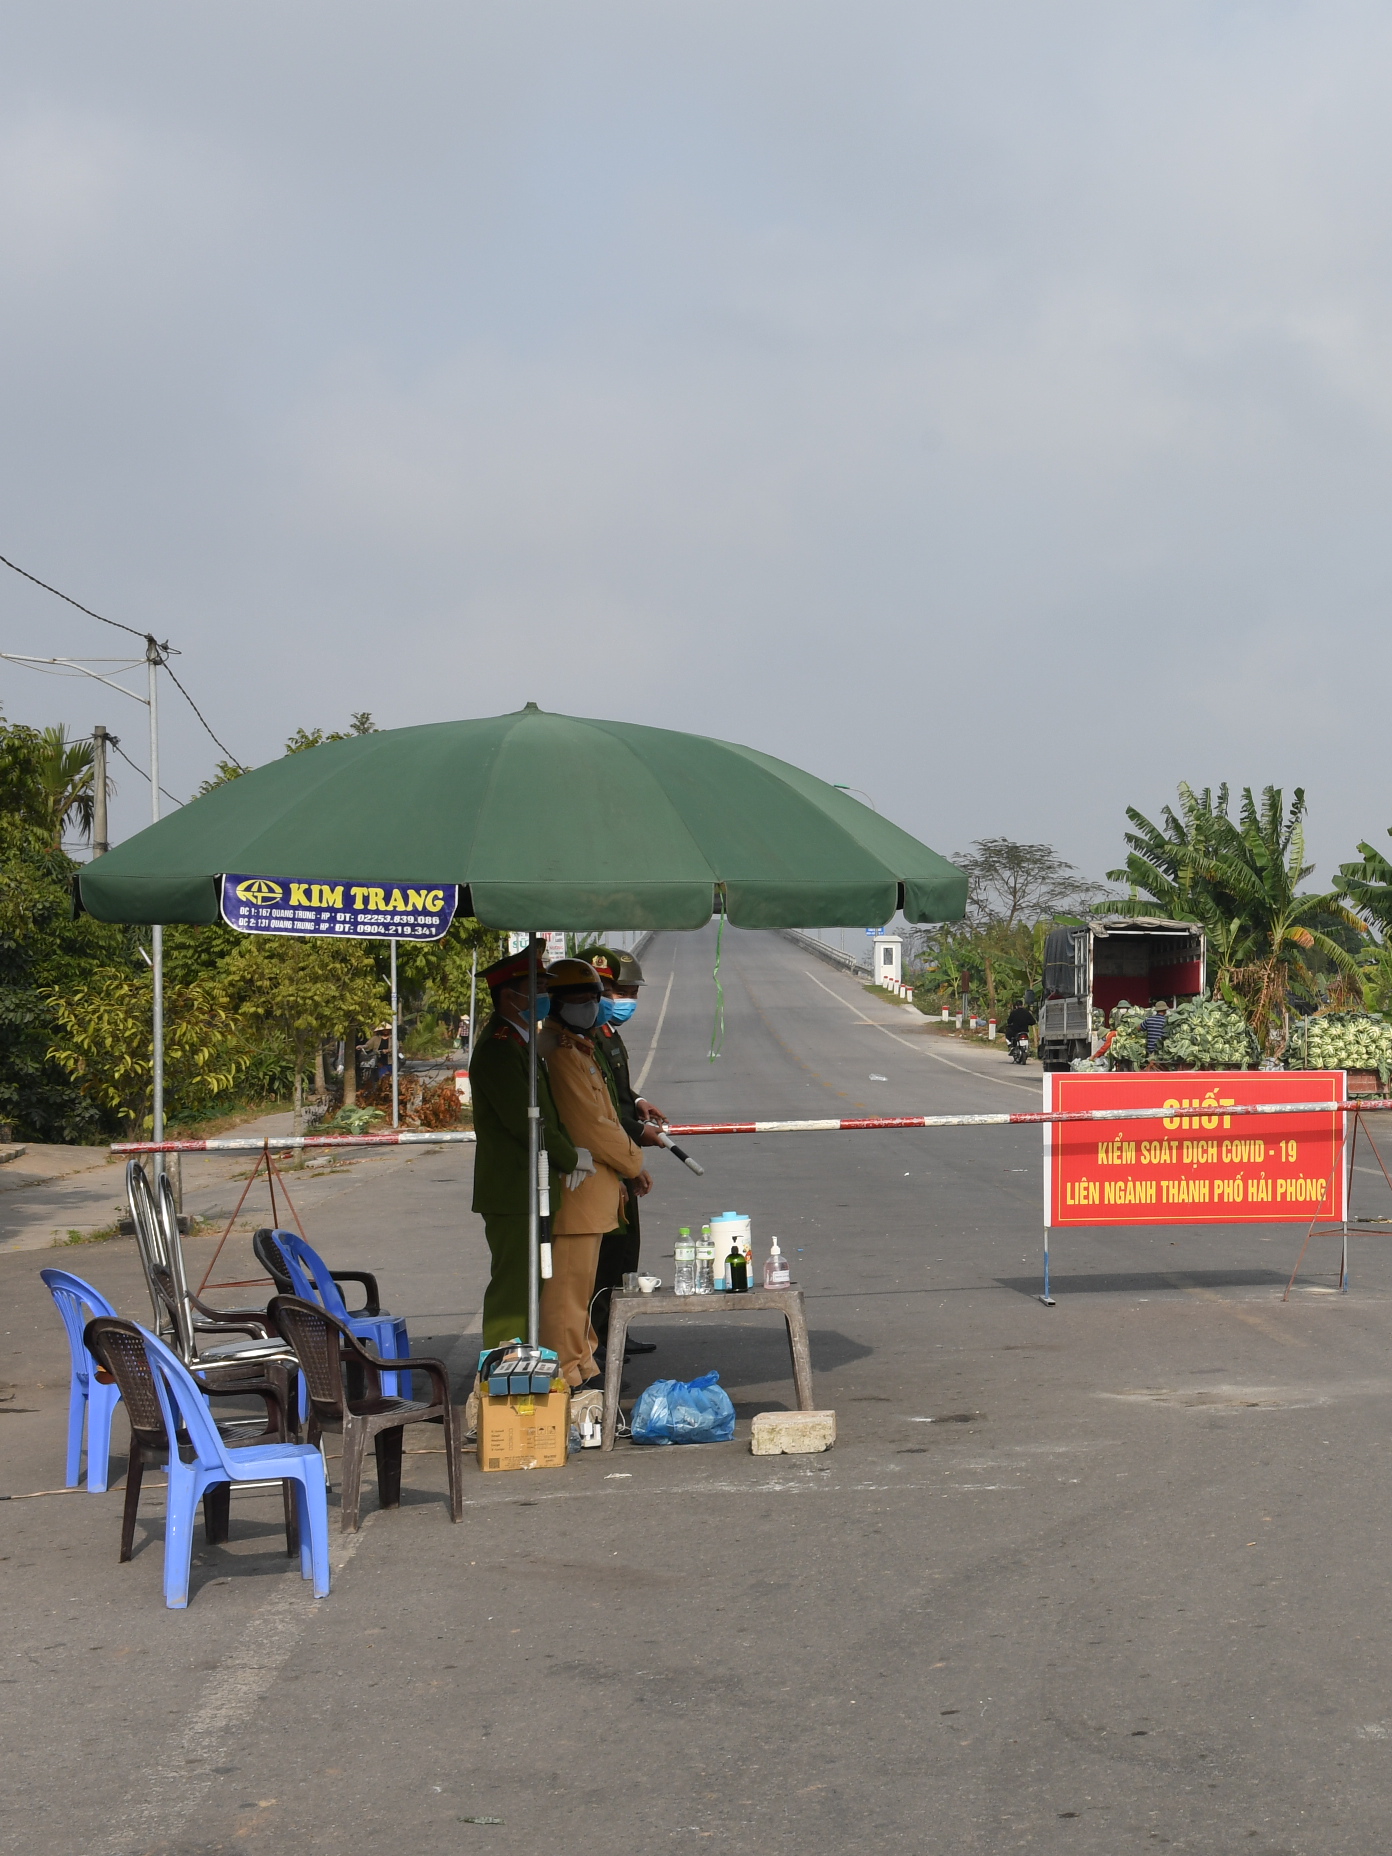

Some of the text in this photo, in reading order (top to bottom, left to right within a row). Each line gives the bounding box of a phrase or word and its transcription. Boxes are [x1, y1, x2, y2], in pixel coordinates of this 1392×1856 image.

[289, 883, 445, 912] KIM TRANG
[258, 919, 269, 927] 131
[270, 920, 293, 929] QUANG
[294, 921, 315, 930] TRUNG
[319, 923, 329, 931] HP
[356, 925, 437, 936] 0904.219.341
[259, 908, 271, 917] 167
[271, 909, 294, 918] QUANG
[295, 910, 316, 920] TRUNG
[321, 912, 331, 921] HP
[1162, 1087, 1235, 1130] CHỐT
[1098, 1132, 1136, 1165] KIỂM
[1140, 1136, 1179, 1165] SOÁT
[1183, 1140, 1218, 1168] DỊCH
[1222, 1139, 1265, 1164] COVID
[1279, 1139, 1297, 1163] 19
[1066, 1171, 1327, 1205] LIÊN NGÀNH THÀNH PHỐ HẢI PHÒNG
